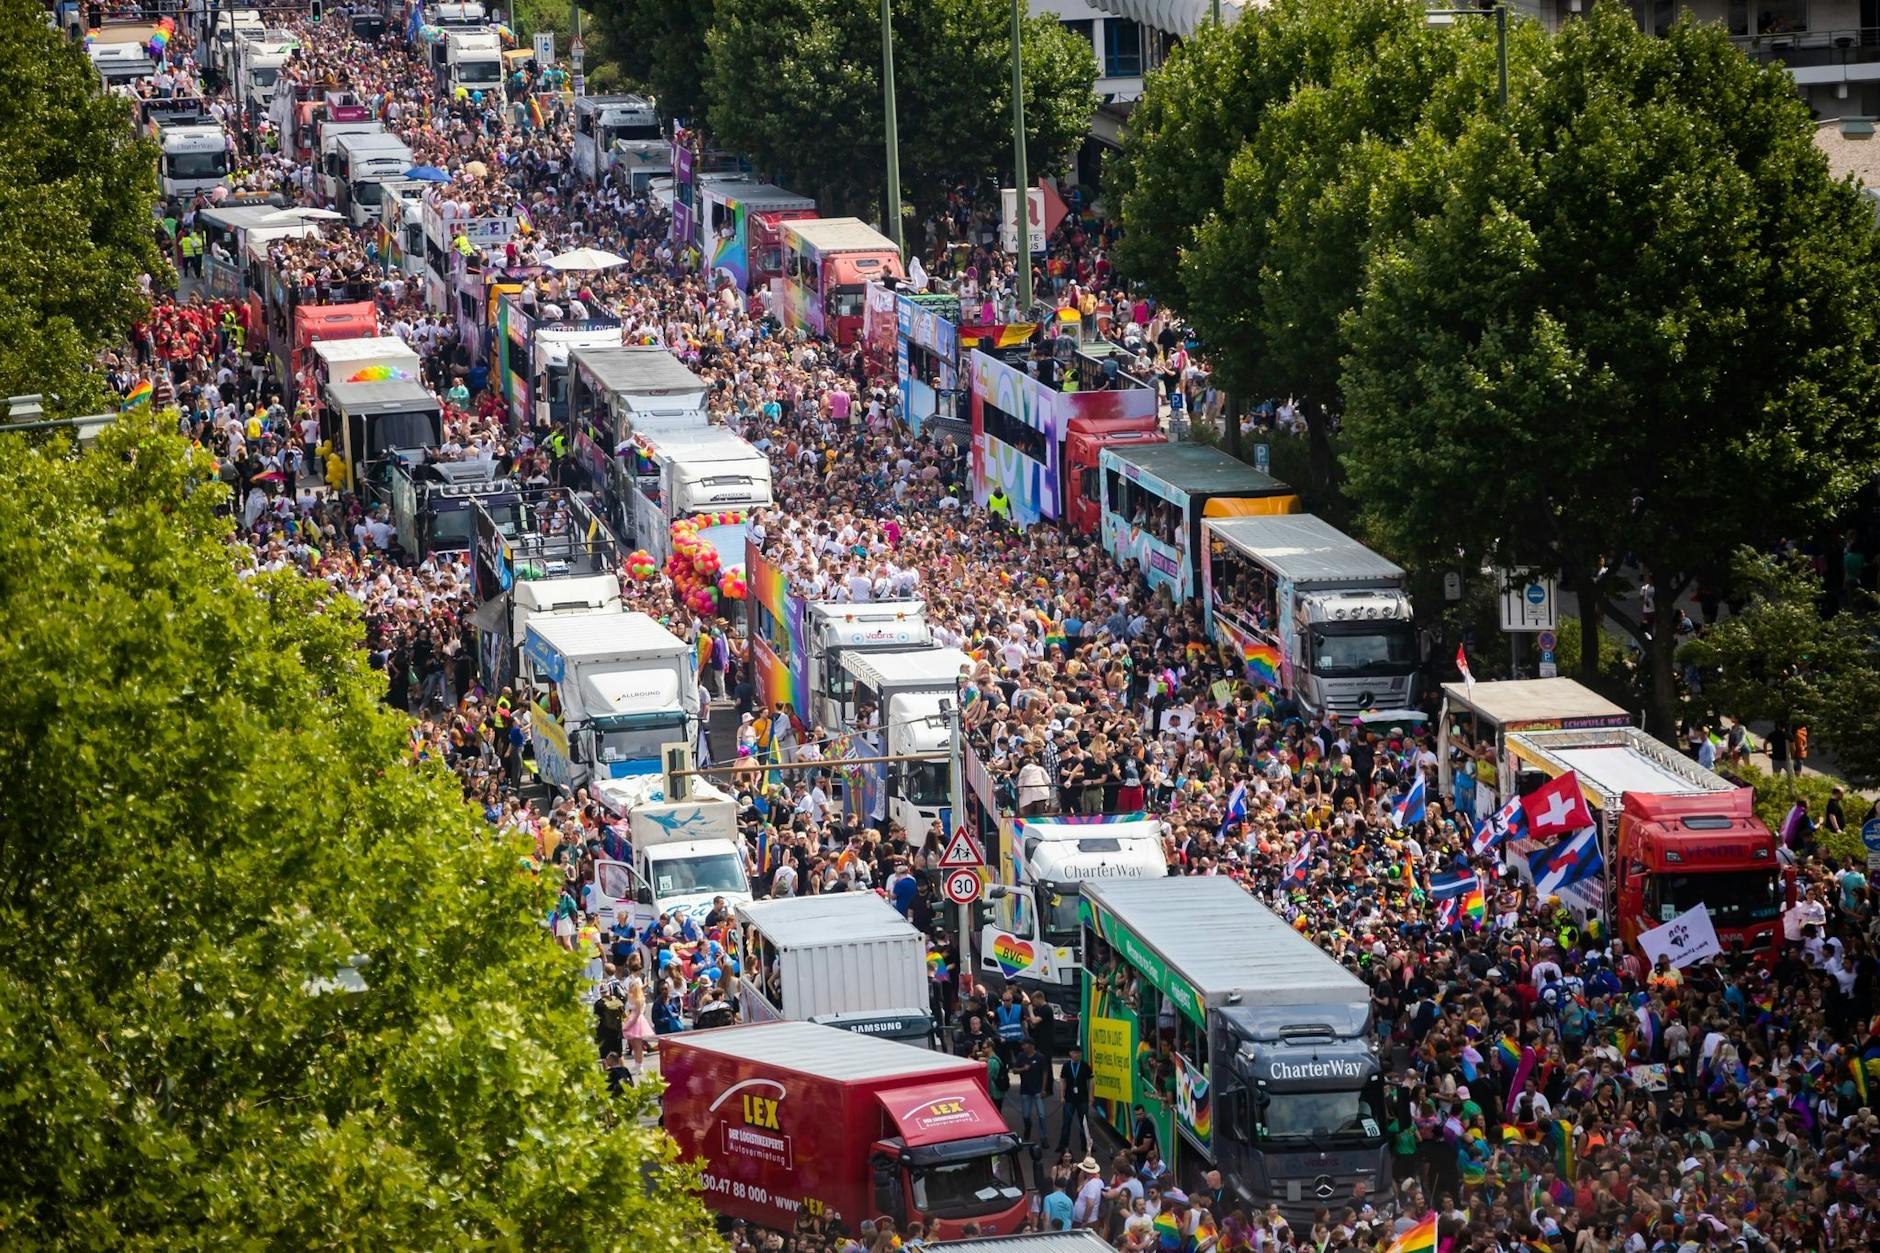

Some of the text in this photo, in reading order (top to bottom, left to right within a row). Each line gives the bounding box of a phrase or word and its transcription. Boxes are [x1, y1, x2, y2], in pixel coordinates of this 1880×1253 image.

[1064, 864, 1144, 881] CharterWay
[954, 879, 973, 894] 30
[1003, 947, 1022, 964] BVG
[850, 1021, 902, 1033] SAMSUNG
[1270, 1059, 1363, 1080] CharterWay
[743, 1094, 780, 1130] LEX
[930, 1102, 963, 1116] LEX
[1367, 1126, 1378, 1137] 10
[729, 1143, 785, 1166] Autovermietung
[733, 1181, 746, 1198] 88
[748, 1185, 767, 1203] 000
